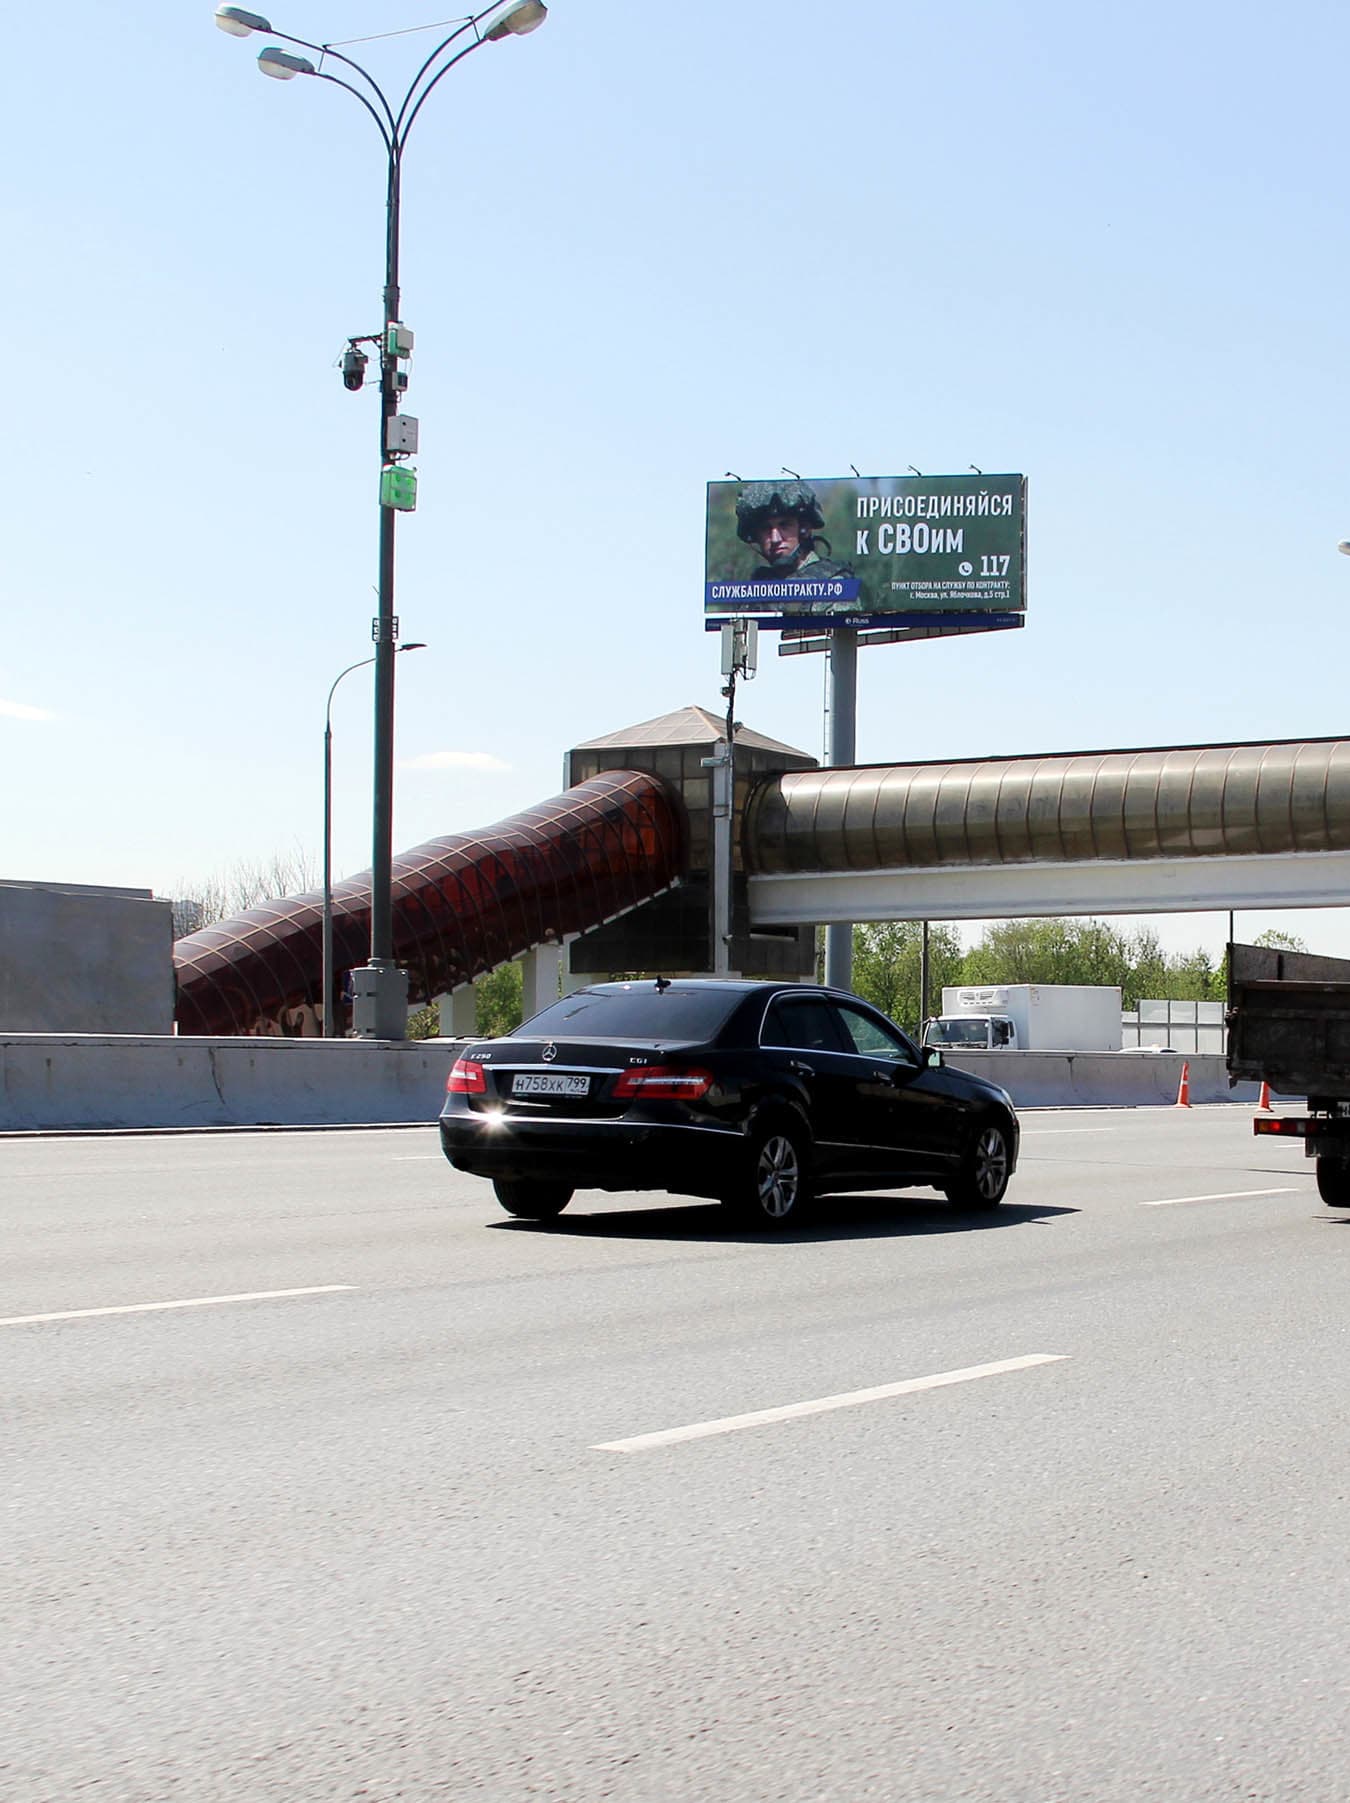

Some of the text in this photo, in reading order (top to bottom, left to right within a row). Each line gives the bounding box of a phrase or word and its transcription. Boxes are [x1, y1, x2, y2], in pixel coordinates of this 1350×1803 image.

[857, 490, 1013, 519] ПРИСОЕДИНЯЙСЯ
[980, 555, 1010, 577] 117
[712, 583, 843, 599] СЛУЖБАПОКОНТРАКТУ.РФ
